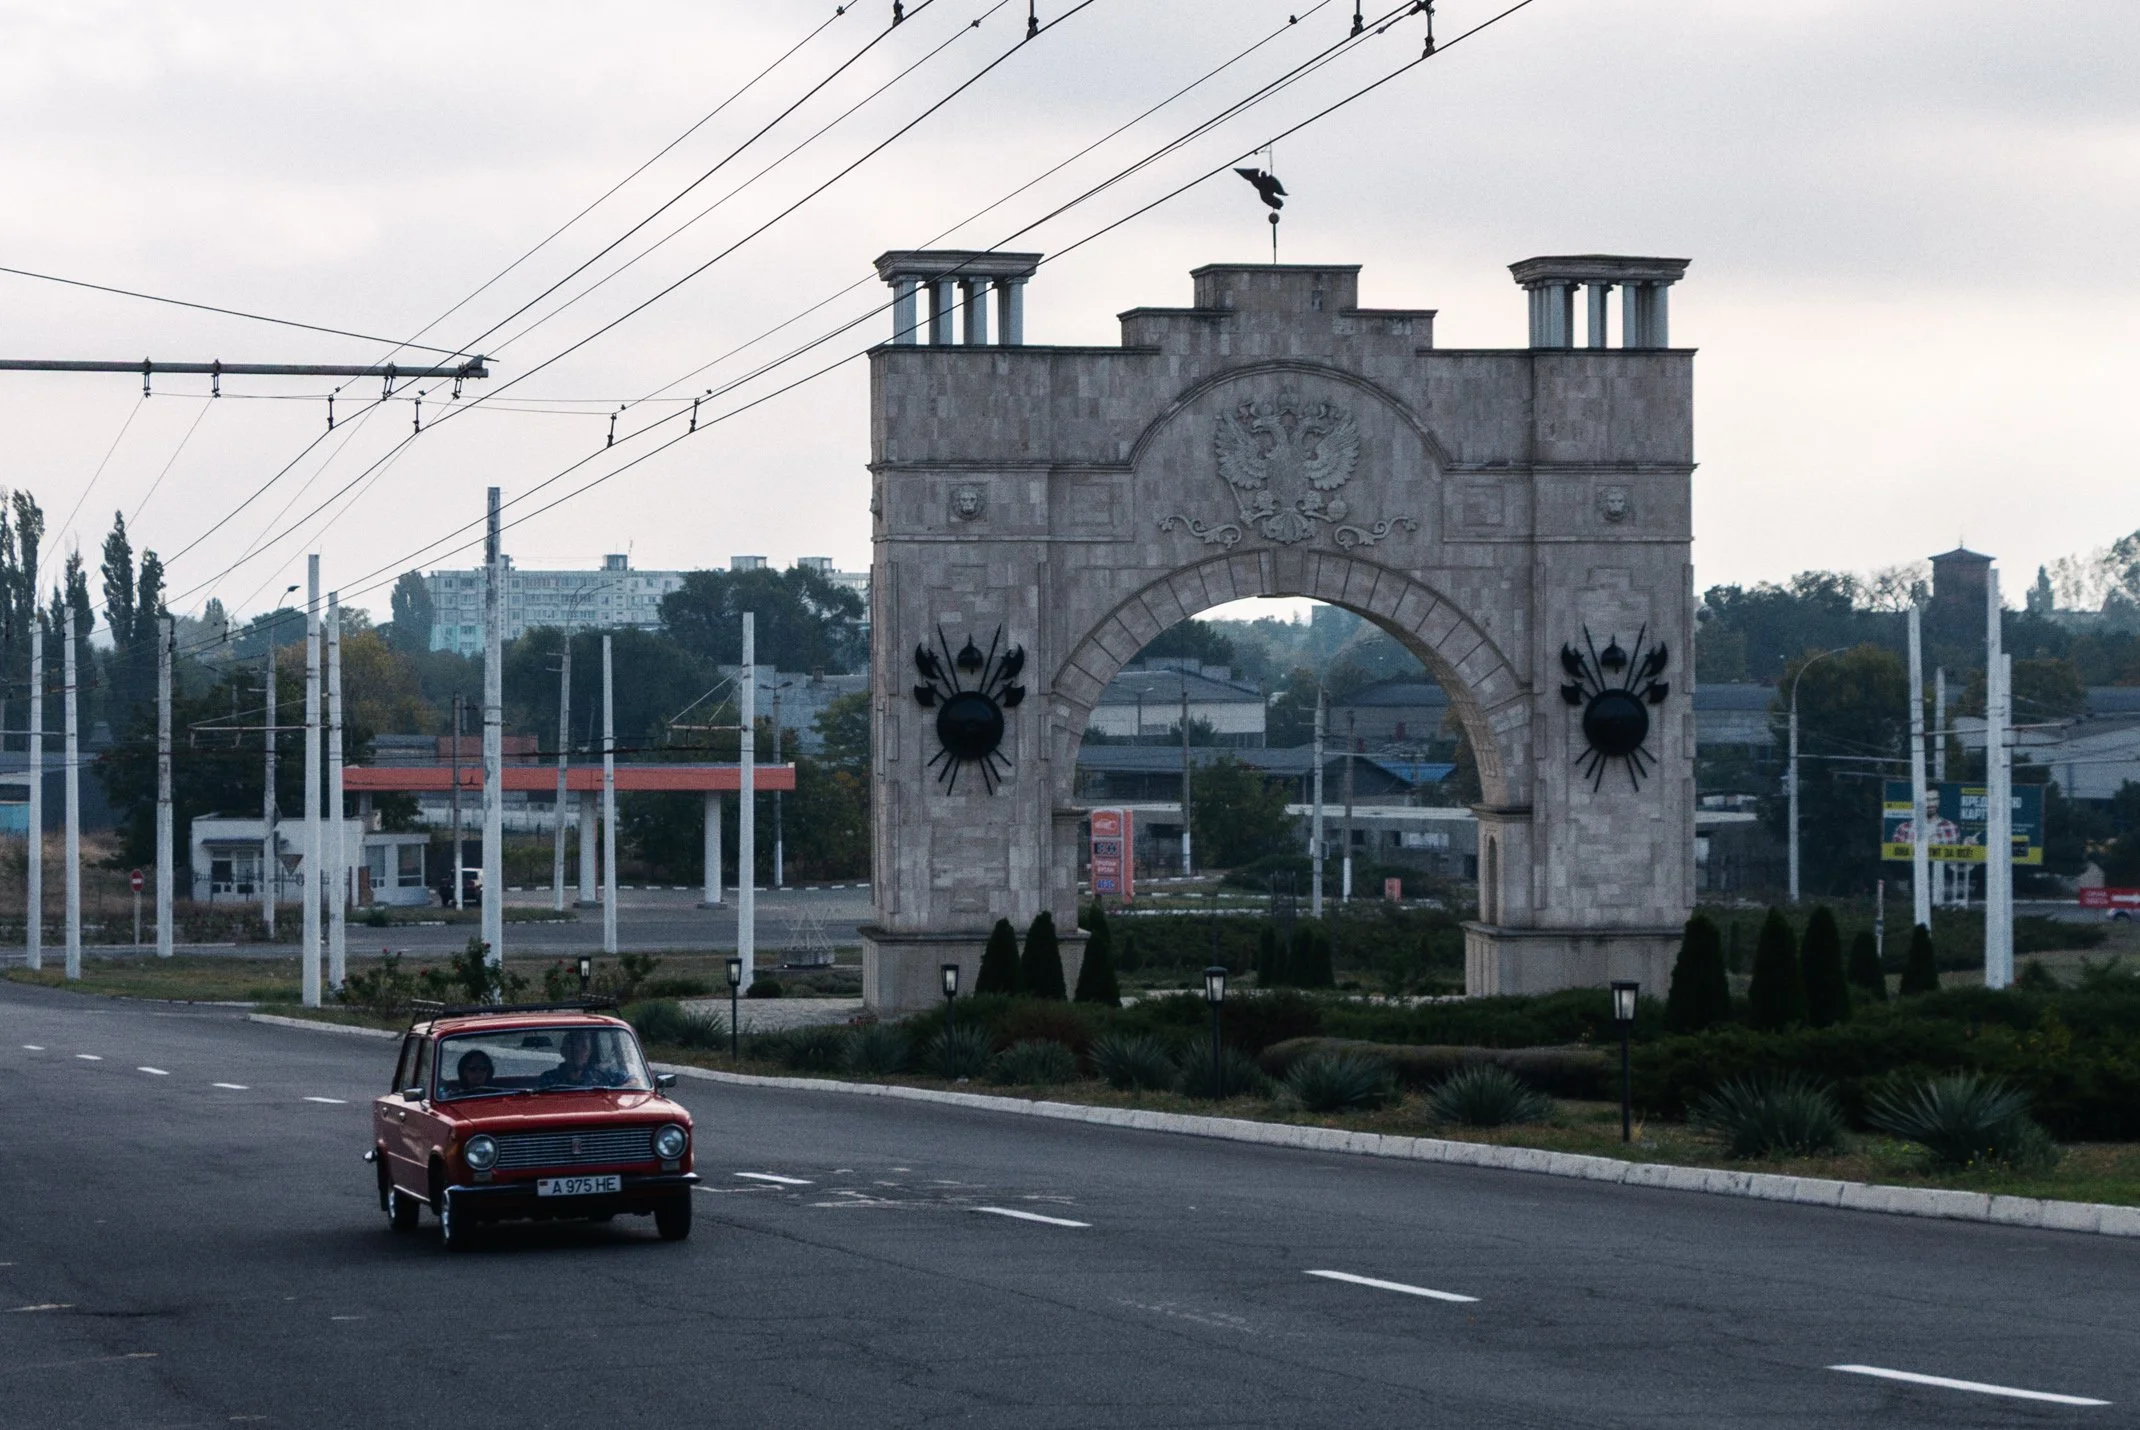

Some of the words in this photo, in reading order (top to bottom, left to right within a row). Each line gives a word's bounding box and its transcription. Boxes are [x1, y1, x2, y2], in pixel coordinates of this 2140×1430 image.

[1961, 808, 1989, 820] КАРТ
[552, 1180, 562, 1194] A
[566, 1179, 592, 1193] 975
[596, 1177, 617, 1192] HE
